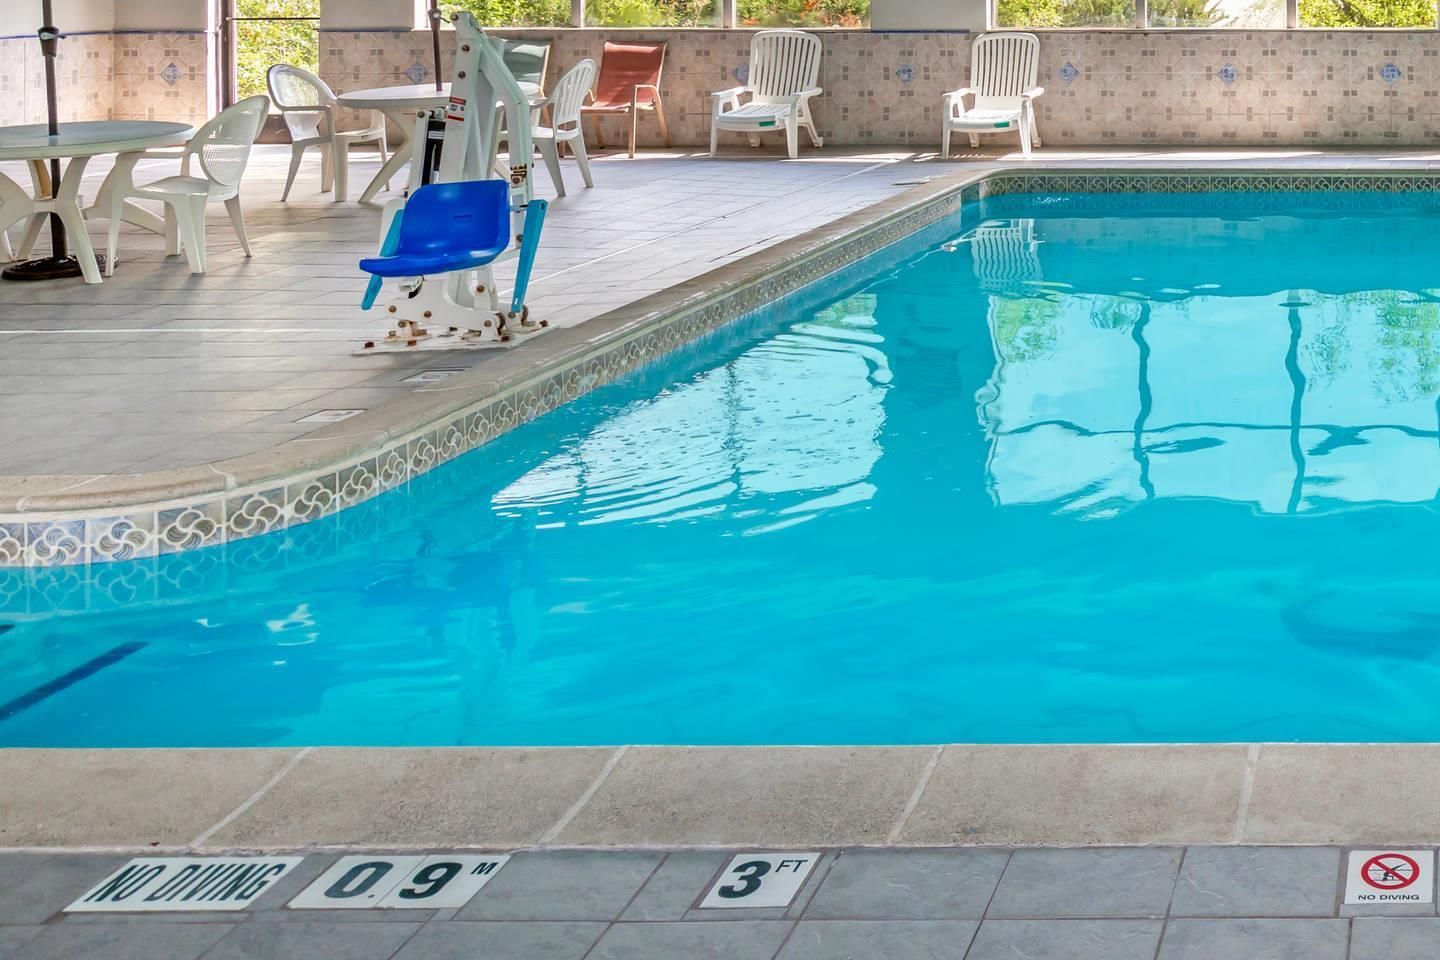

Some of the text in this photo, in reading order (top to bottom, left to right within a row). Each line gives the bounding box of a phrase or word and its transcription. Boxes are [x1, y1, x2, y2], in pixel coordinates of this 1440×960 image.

[83, 863, 288, 903] NO DIVING
[323, 861, 499, 900] 0.9 M
[717, 859, 809, 899] 3 FT
